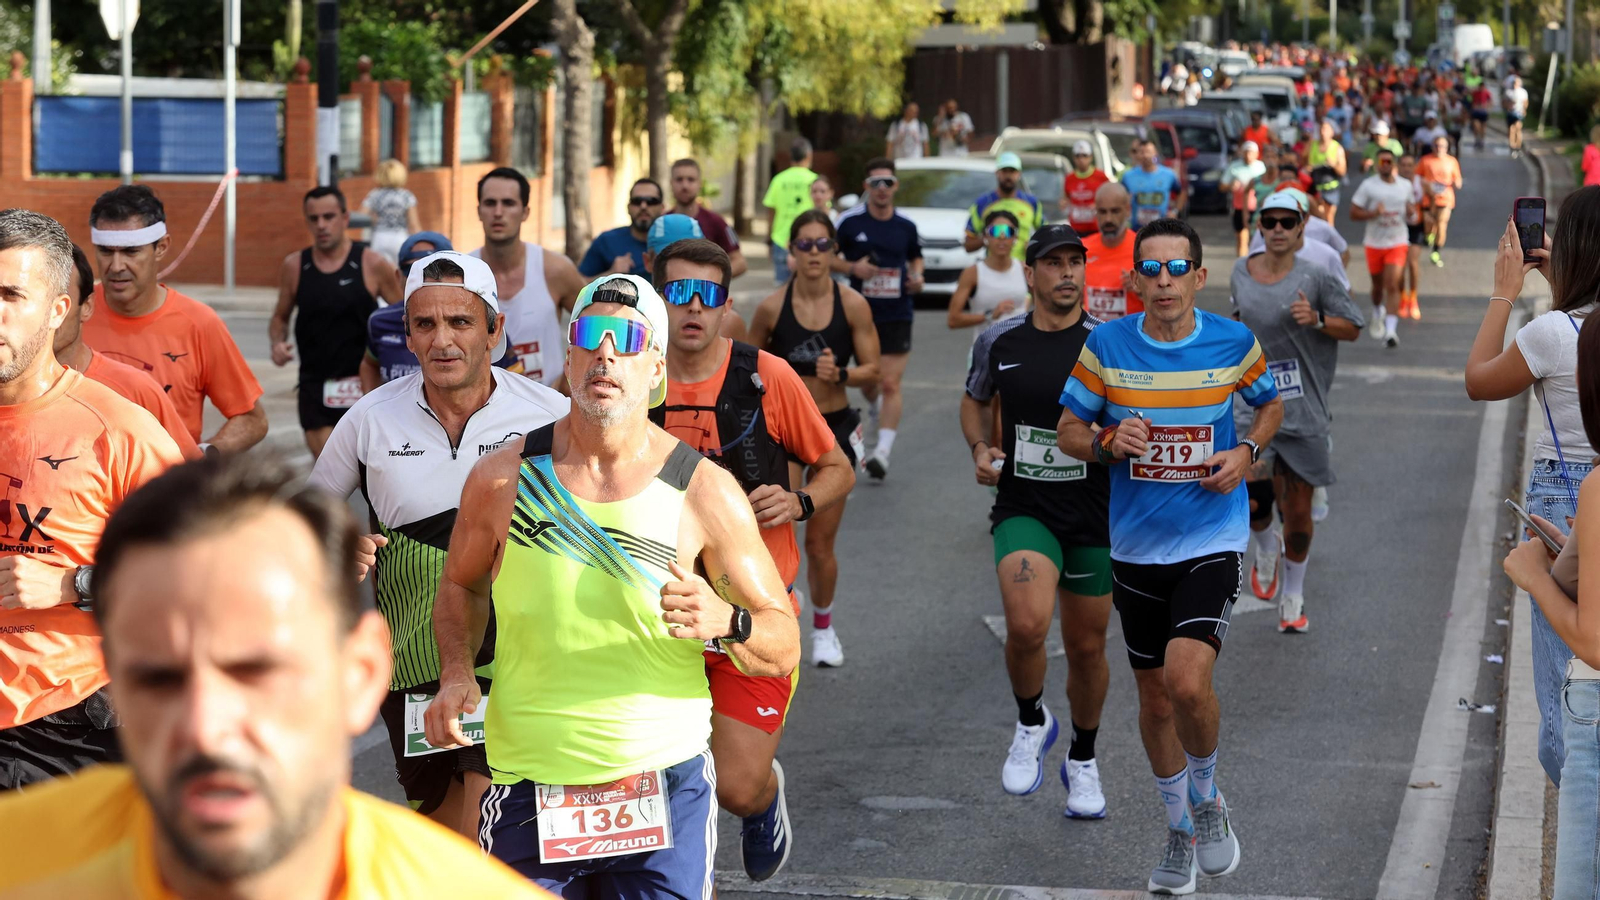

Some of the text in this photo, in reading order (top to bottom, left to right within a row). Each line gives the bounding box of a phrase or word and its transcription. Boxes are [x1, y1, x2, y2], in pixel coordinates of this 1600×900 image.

[1043, 448, 1055, 464] 6
[1150, 444, 1193, 464] 219
[37, 545, 55, 554] DE
[571, 804, 634, 833] 136
